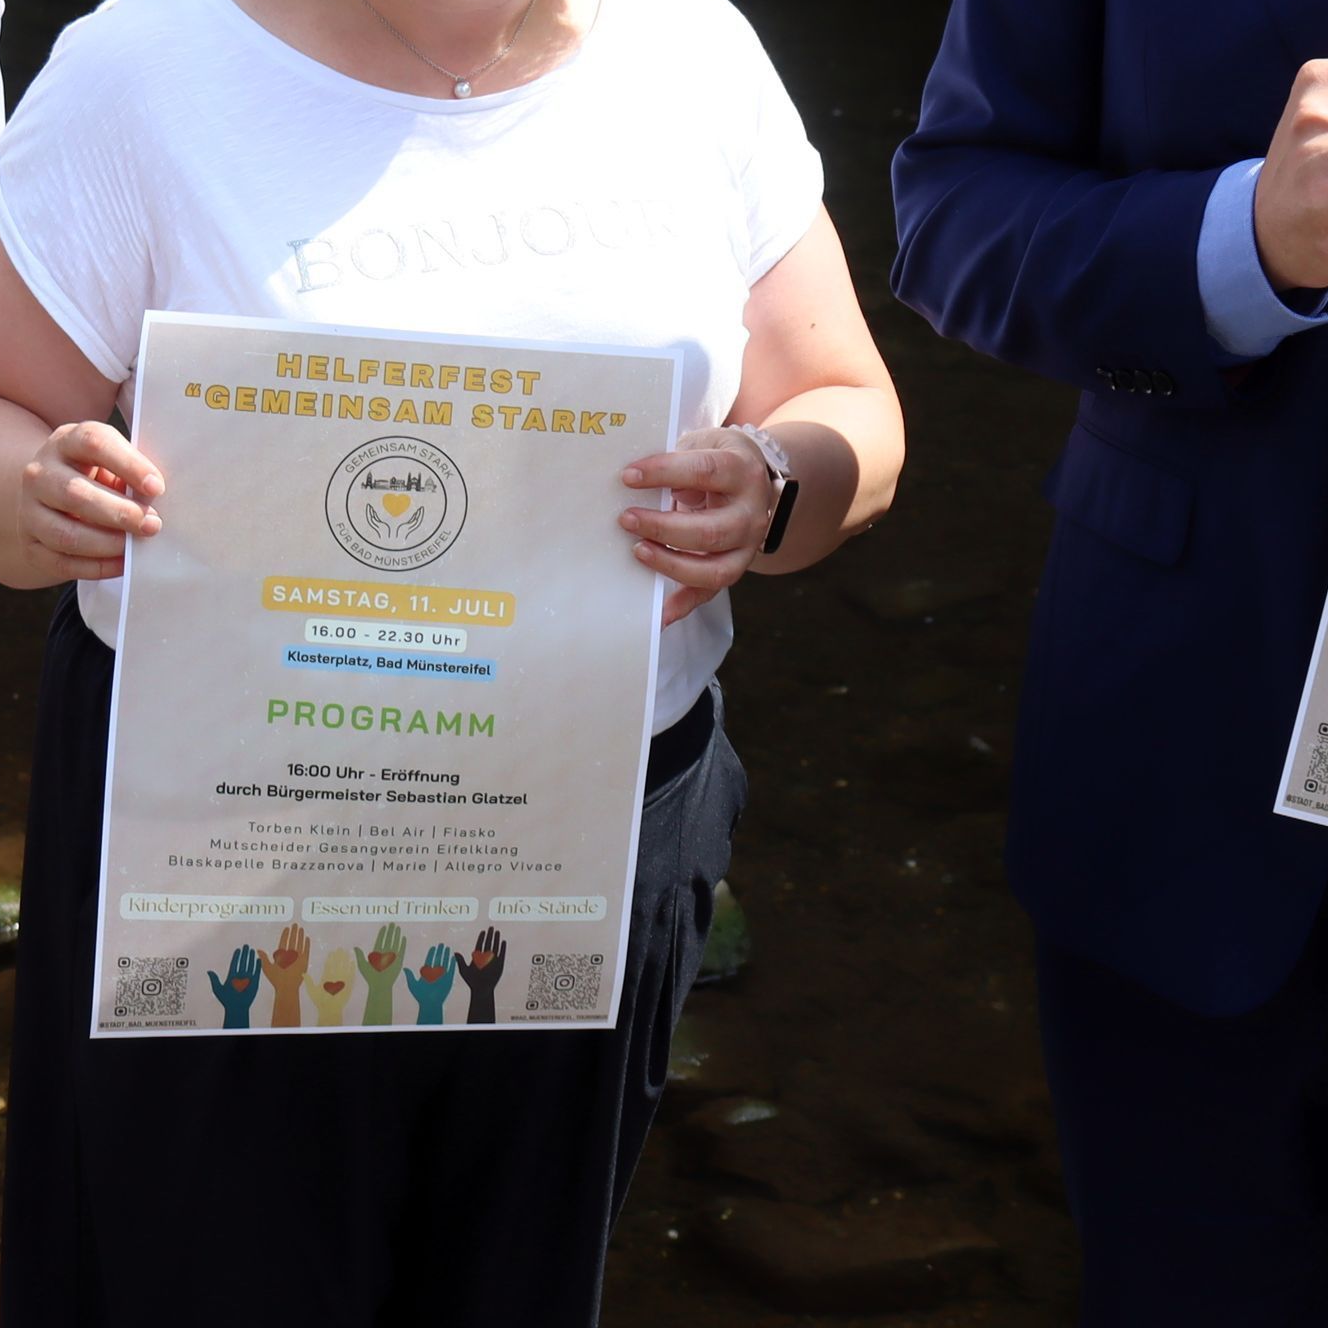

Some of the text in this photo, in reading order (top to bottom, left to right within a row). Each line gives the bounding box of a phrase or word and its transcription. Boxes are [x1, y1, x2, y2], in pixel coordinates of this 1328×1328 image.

[277, 353, 540, 395] HELFERFEST
[185, 383, 625, 434] “GEMEINSAM STARK”
[345, 442, 455, 480] GEMEINSAM STARK
[336, 522, 452, 566] FÜR BAD MÜNSTEREIFEL
[272, 585, 504, 617] SAMSTAG, 11. JULI
[312, 625, 356, 639] 16.00
[377, 629, 424, 643] 22.30
[431, 633, 460, 646] Uhr
[287, 650, 491, 675] Klosterplatz, Bad Münstereifel
[267, 698, 495, 738] PROGRAMM
[287, 763, 331, 778] 16:00
[335, 766, 365, 779] Uhr
[380, 768, 460, 786] Eröffnung
[215, 781, 527, 804] durch Bürgermeister Sebastian Glatzel
[248, 821, 496, 838] Torben Klein Bel Air Fiasko
[209, 838, 518, 857] Mutscheider Gesangverein Eifelklang
[167, 854, 562, 874] Blaskapelle Brazzanova Marie Allegro Vivace
[128, 897, 286, 916] Kinderprogramm
[310, 899, 470, 915] Essen und Trinken
[497, 898, 599, 914] Info Stände
